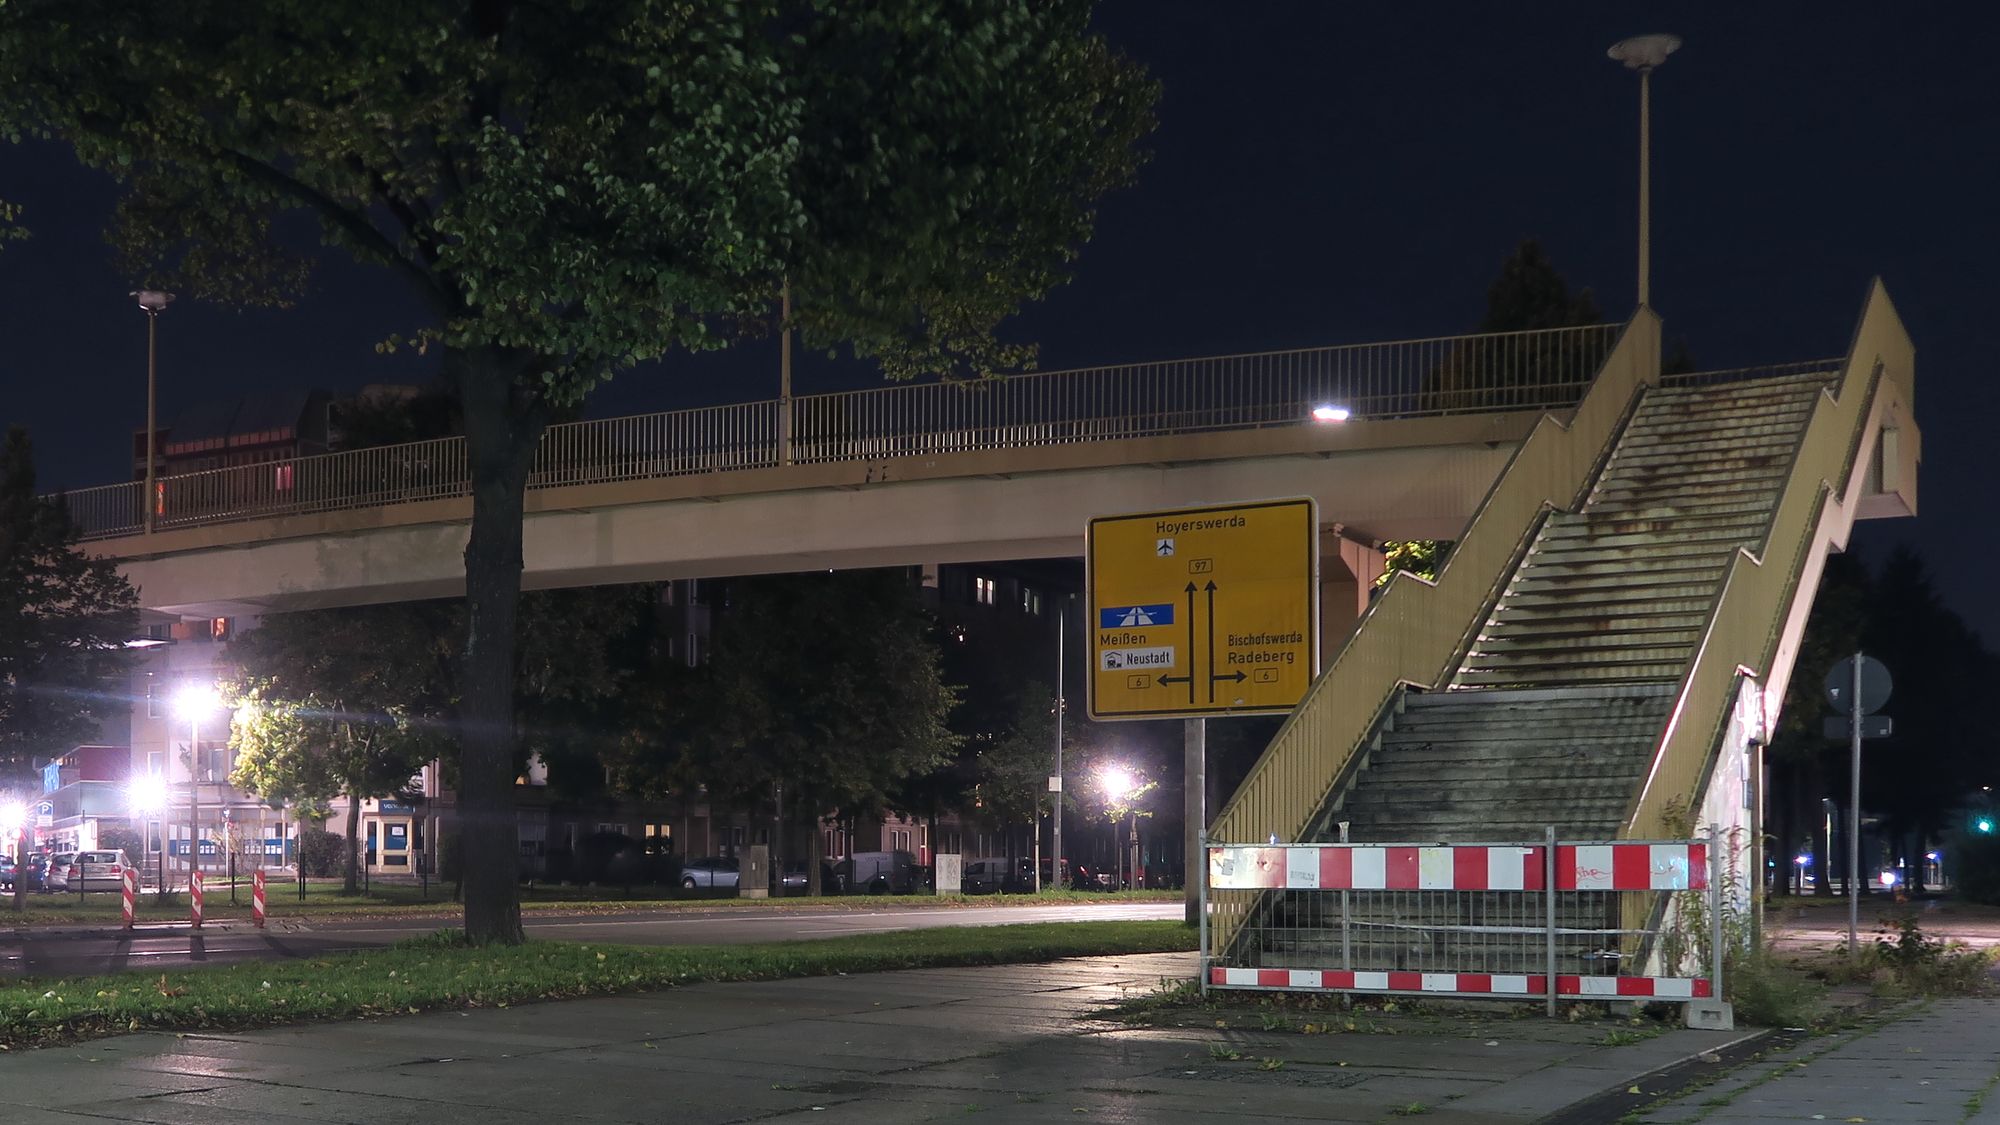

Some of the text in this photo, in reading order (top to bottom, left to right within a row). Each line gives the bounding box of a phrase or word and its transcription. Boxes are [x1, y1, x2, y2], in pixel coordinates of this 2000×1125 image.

[1156, 515, 1246, 534] Hoyerswerda
[1194, 561, 1207, 571] 97
[1100, 632, 1147, 646] Meißen
[1228, 631, 1303, 647] Bischofswerda
[1126, 651, 1170, 666] Neustadt
[1228, 650, 1295, 665] Radeberg
[1136, 678, 1142, 687] 6
[1263, 671, 1270, 680] 6
